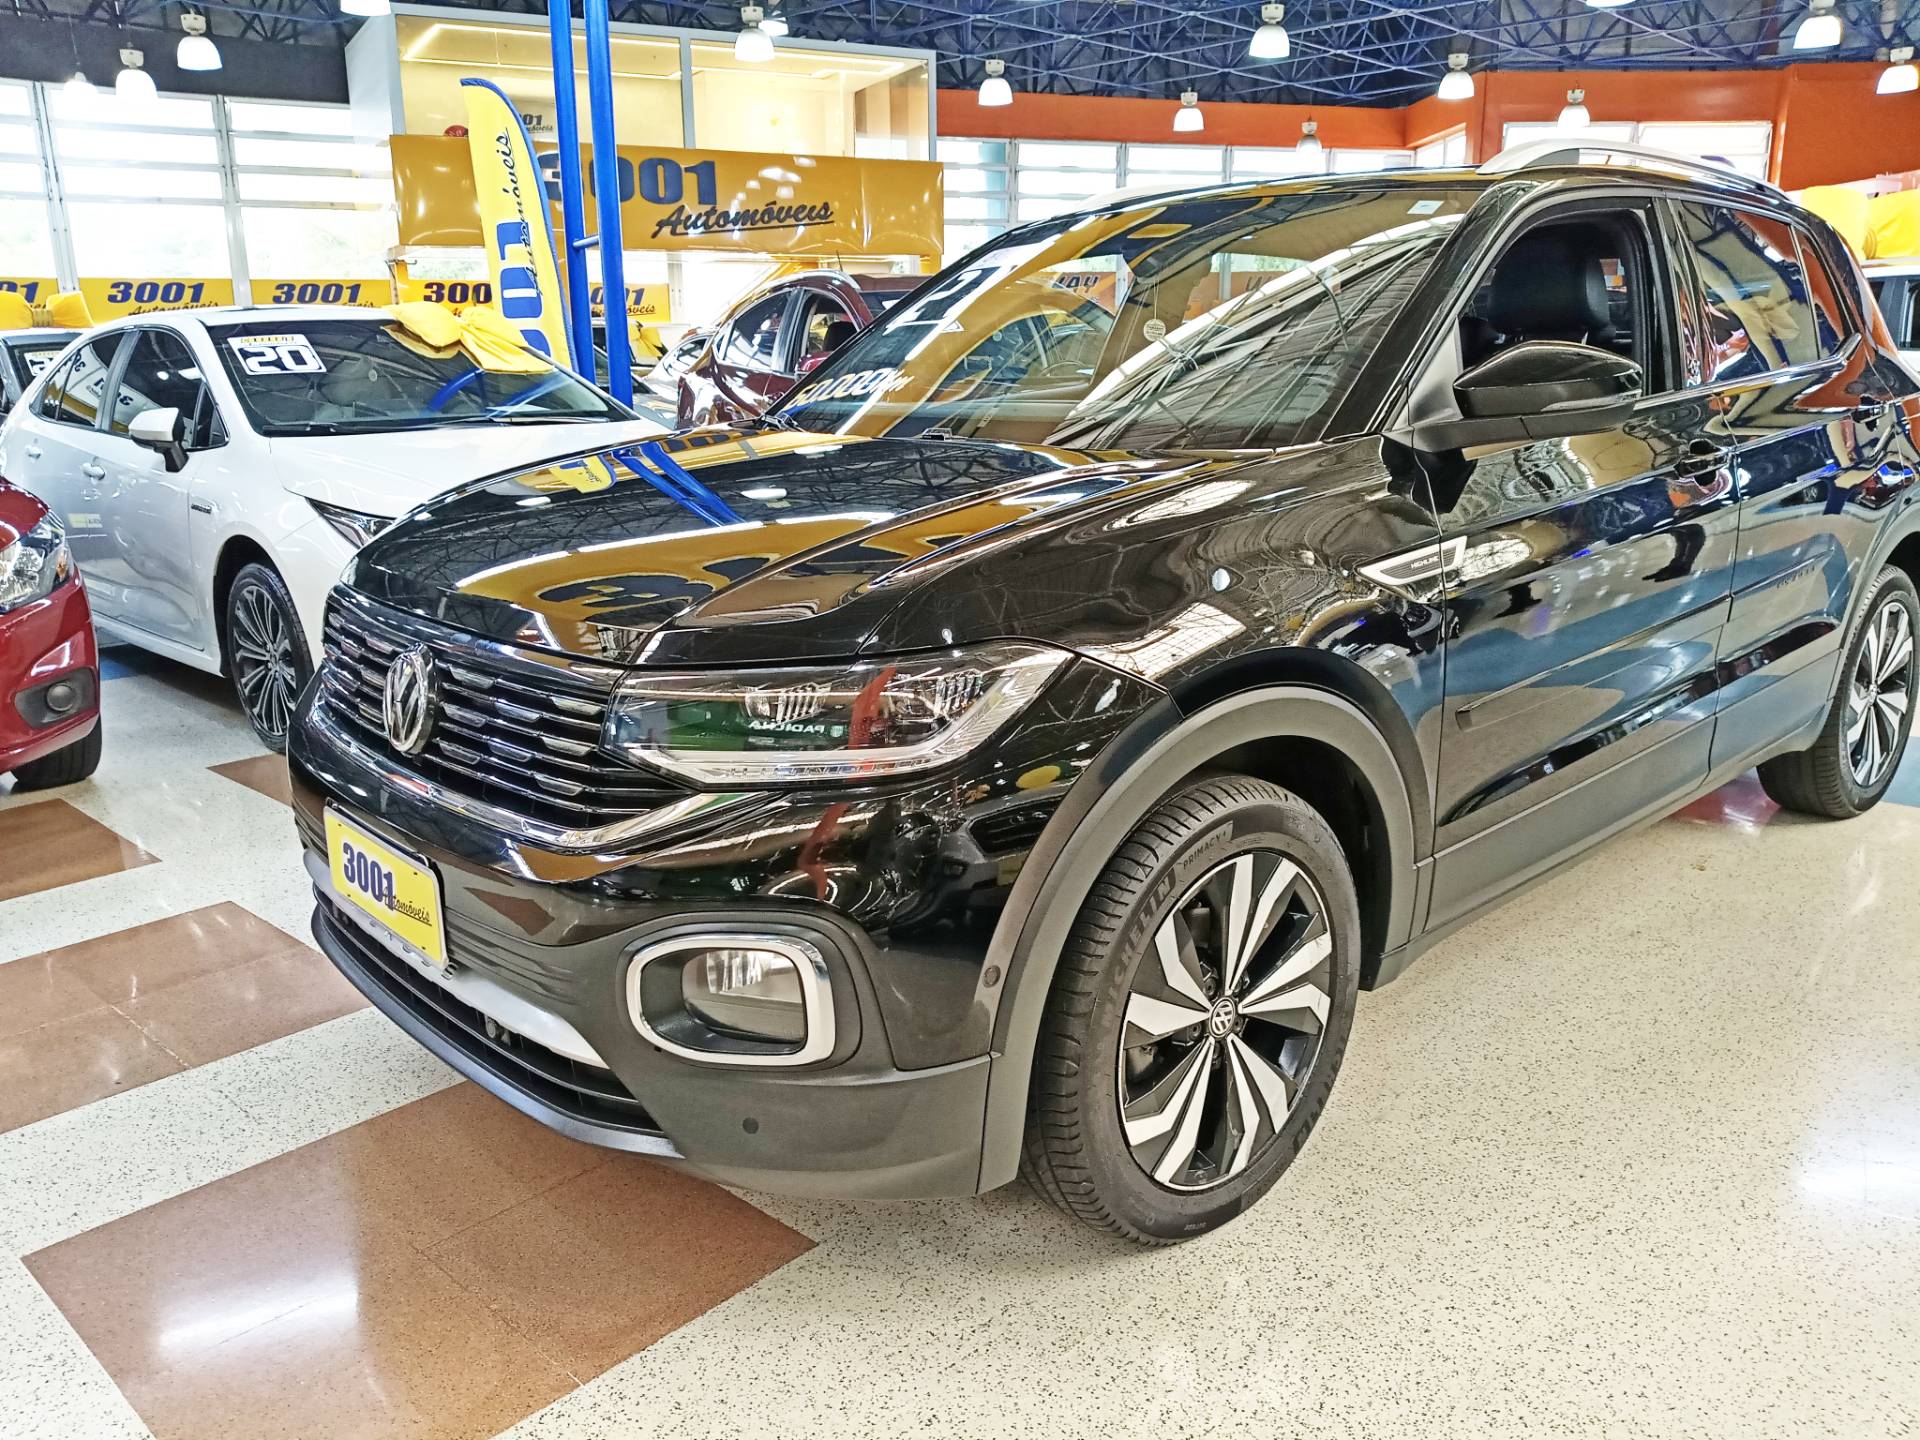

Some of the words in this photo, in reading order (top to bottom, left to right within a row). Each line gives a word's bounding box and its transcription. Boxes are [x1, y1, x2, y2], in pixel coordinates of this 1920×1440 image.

[651, 201, 835, 240] Automóveis
[107, 281, 205, 304] 3001
[272, 283, 362, 304] 3001
[241, 345, 321, 371] 20
[343, 842, 394, 911] 3001
